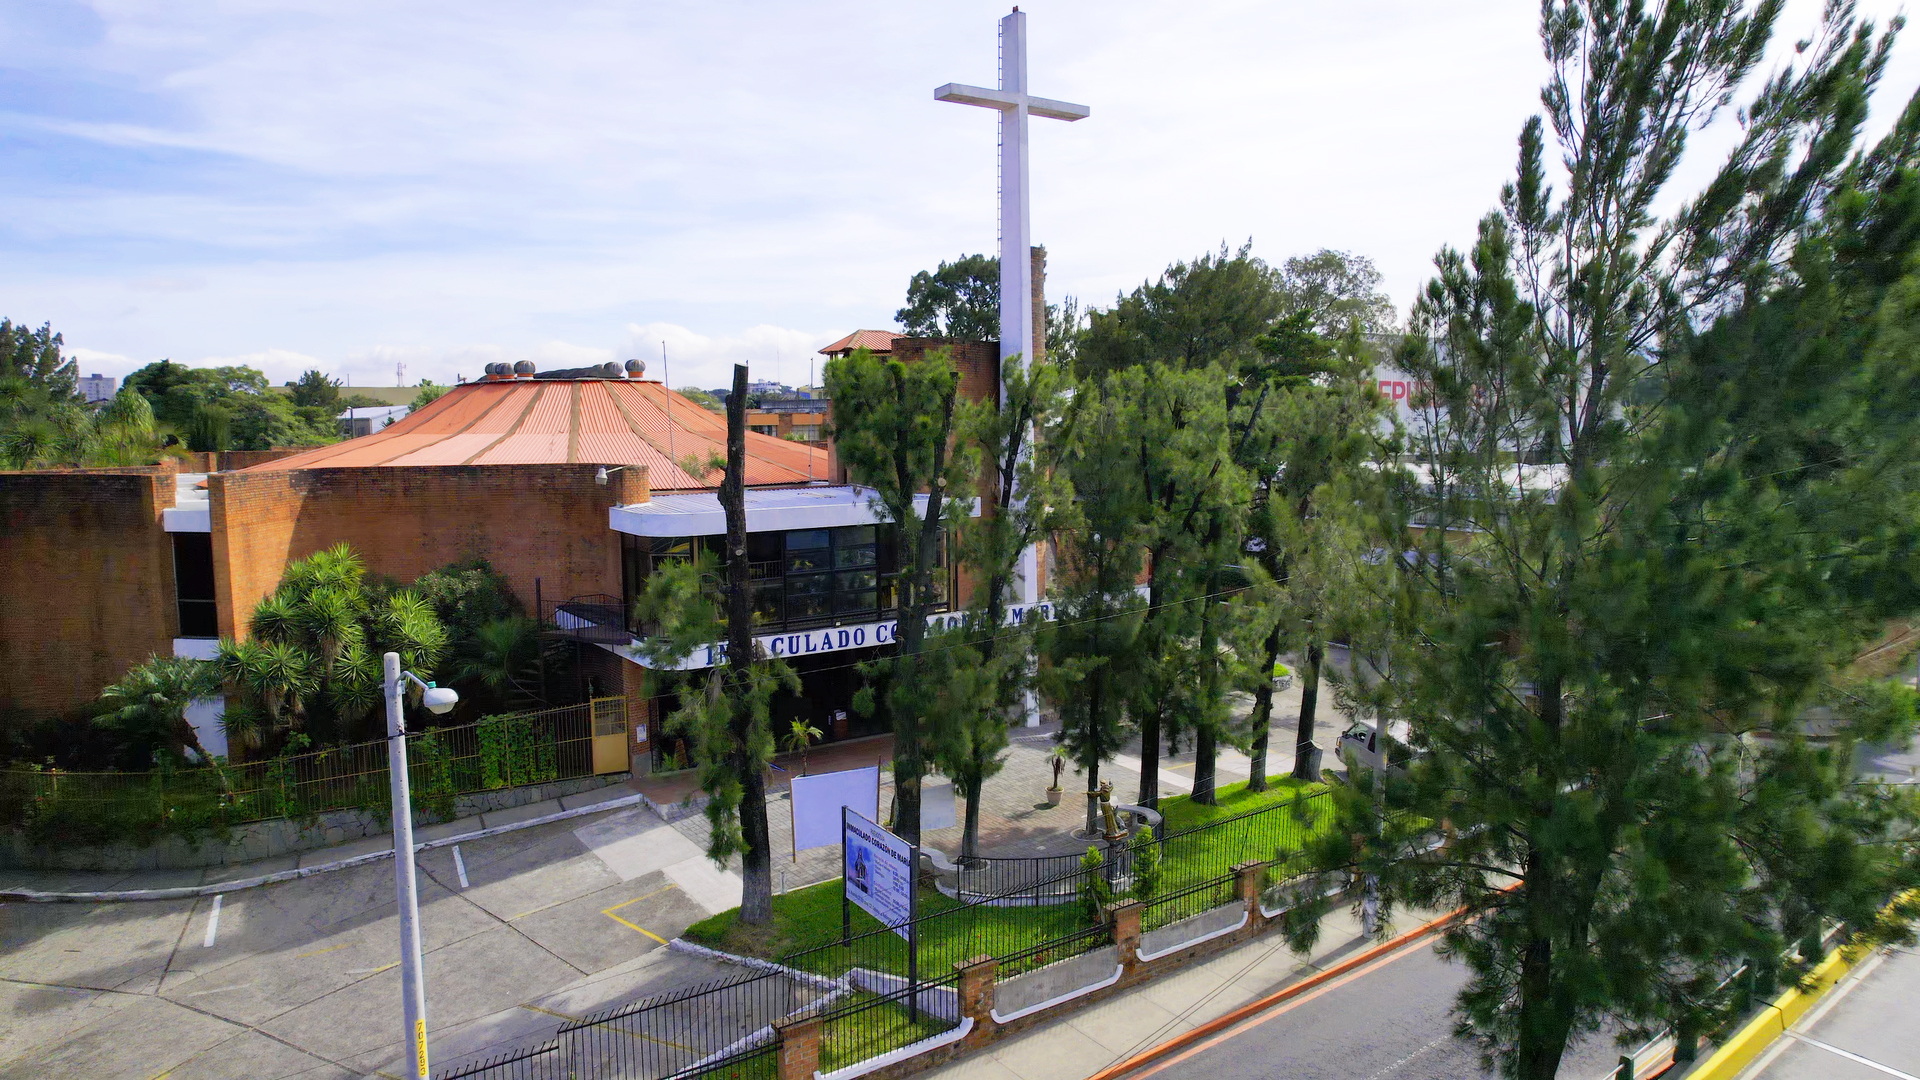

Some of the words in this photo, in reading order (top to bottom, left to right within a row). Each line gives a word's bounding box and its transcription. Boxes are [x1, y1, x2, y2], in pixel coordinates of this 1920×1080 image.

[706, 628, 865, 665] INCULADO
[846, 822, 871, 843] INMACULADO
[891, 849, 897, 860] DE
